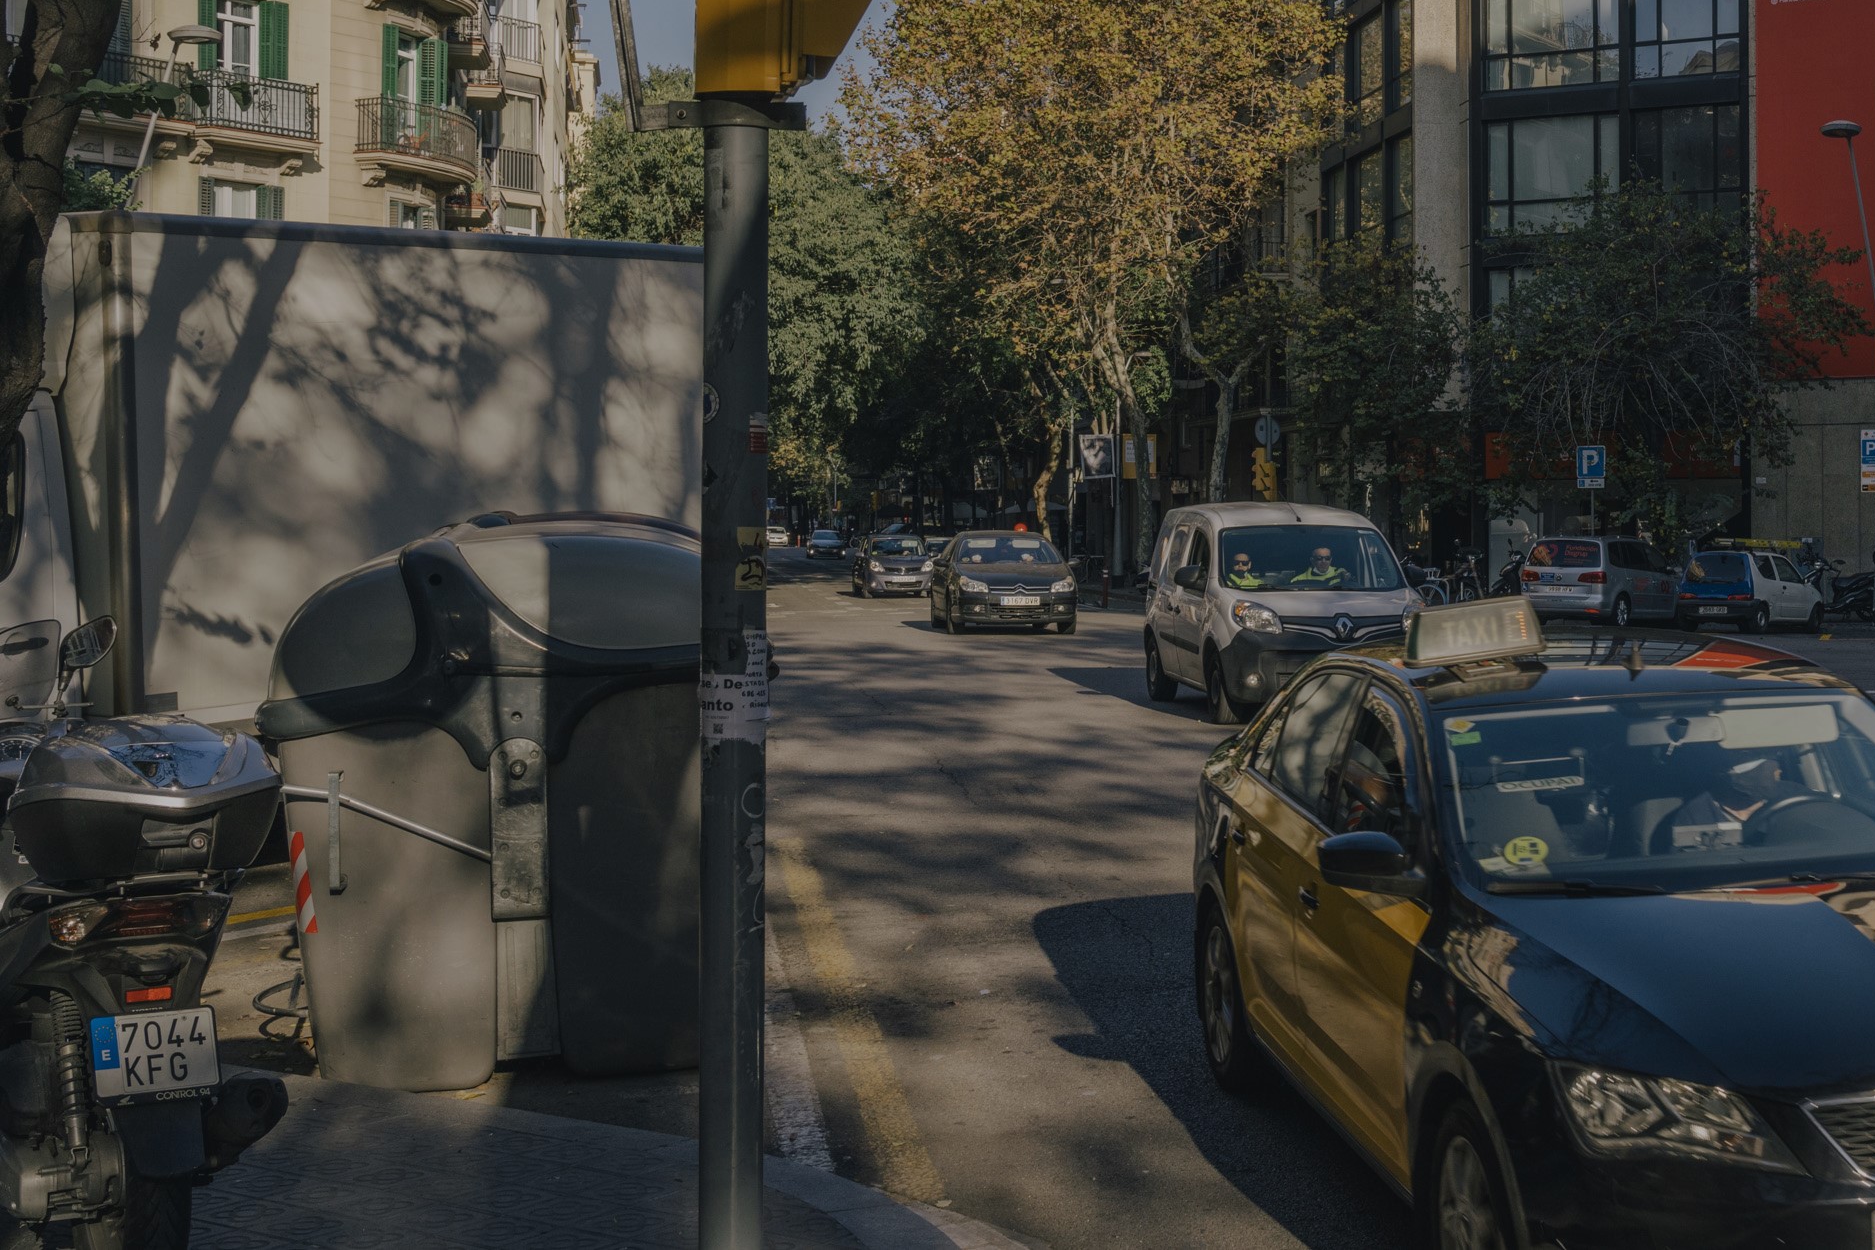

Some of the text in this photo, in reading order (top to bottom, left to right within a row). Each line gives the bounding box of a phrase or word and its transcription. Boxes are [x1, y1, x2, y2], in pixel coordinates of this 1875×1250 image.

[1582, 450, 1599, 474] P
[1442, 616, 1499, 647] TAXI
[121, 1016, 206, 1053] 7044
[101, 1049, 189, 1087] E KFG
[156, 1087, 211, 1101] CONTROL 94
